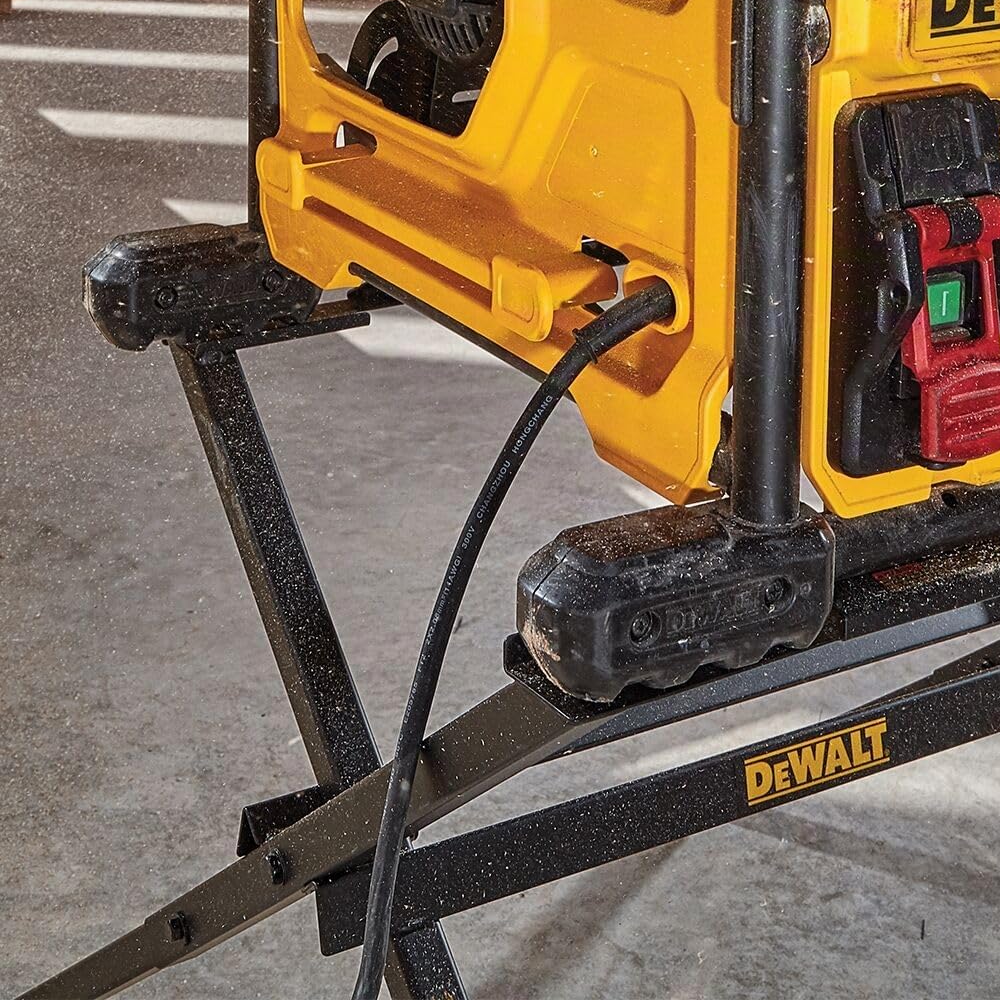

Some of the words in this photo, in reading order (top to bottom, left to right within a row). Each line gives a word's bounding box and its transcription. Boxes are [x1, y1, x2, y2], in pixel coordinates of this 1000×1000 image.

[461, 525, 475, 549] 300V
[476, 460, 511, 519] CHANGZHOU
[512, 395, 553, 454] HONGCHANG
[745, 722, 887, 799] DEWALT
